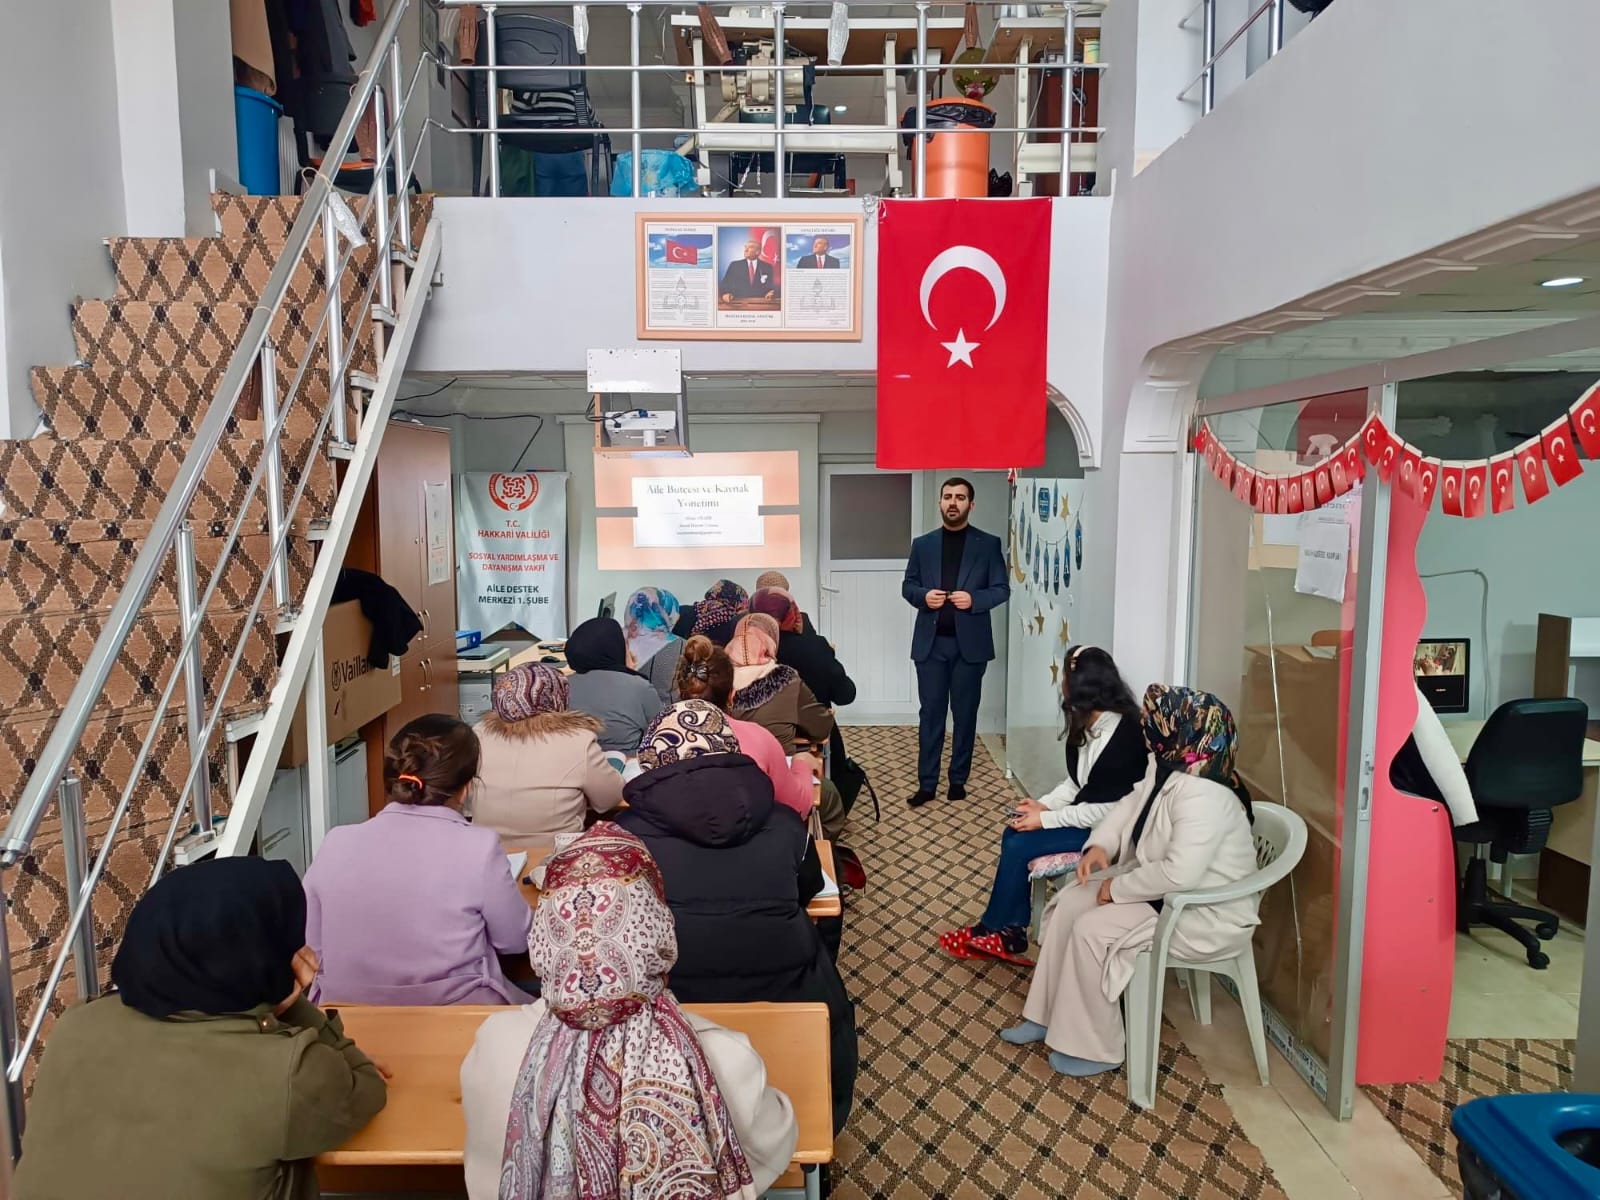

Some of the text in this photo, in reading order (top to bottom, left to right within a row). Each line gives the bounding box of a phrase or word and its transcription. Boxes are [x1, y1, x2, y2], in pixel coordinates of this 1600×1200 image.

[505, 519, 521, 528] T.C.
[477, 529, 550, 539] HAKKARİ VALİLİĞİ
[468, 552, 559, 562] SOSYAL YARDIMLAŞMA VE
[482, 563, 523, 573] DAYANIŞMA
[486, 584, 540, 594] AİLE DESTEK
[478, 595, 516, 605] MERKEZİ
[526, 596, 550, 606] ŞUBE
